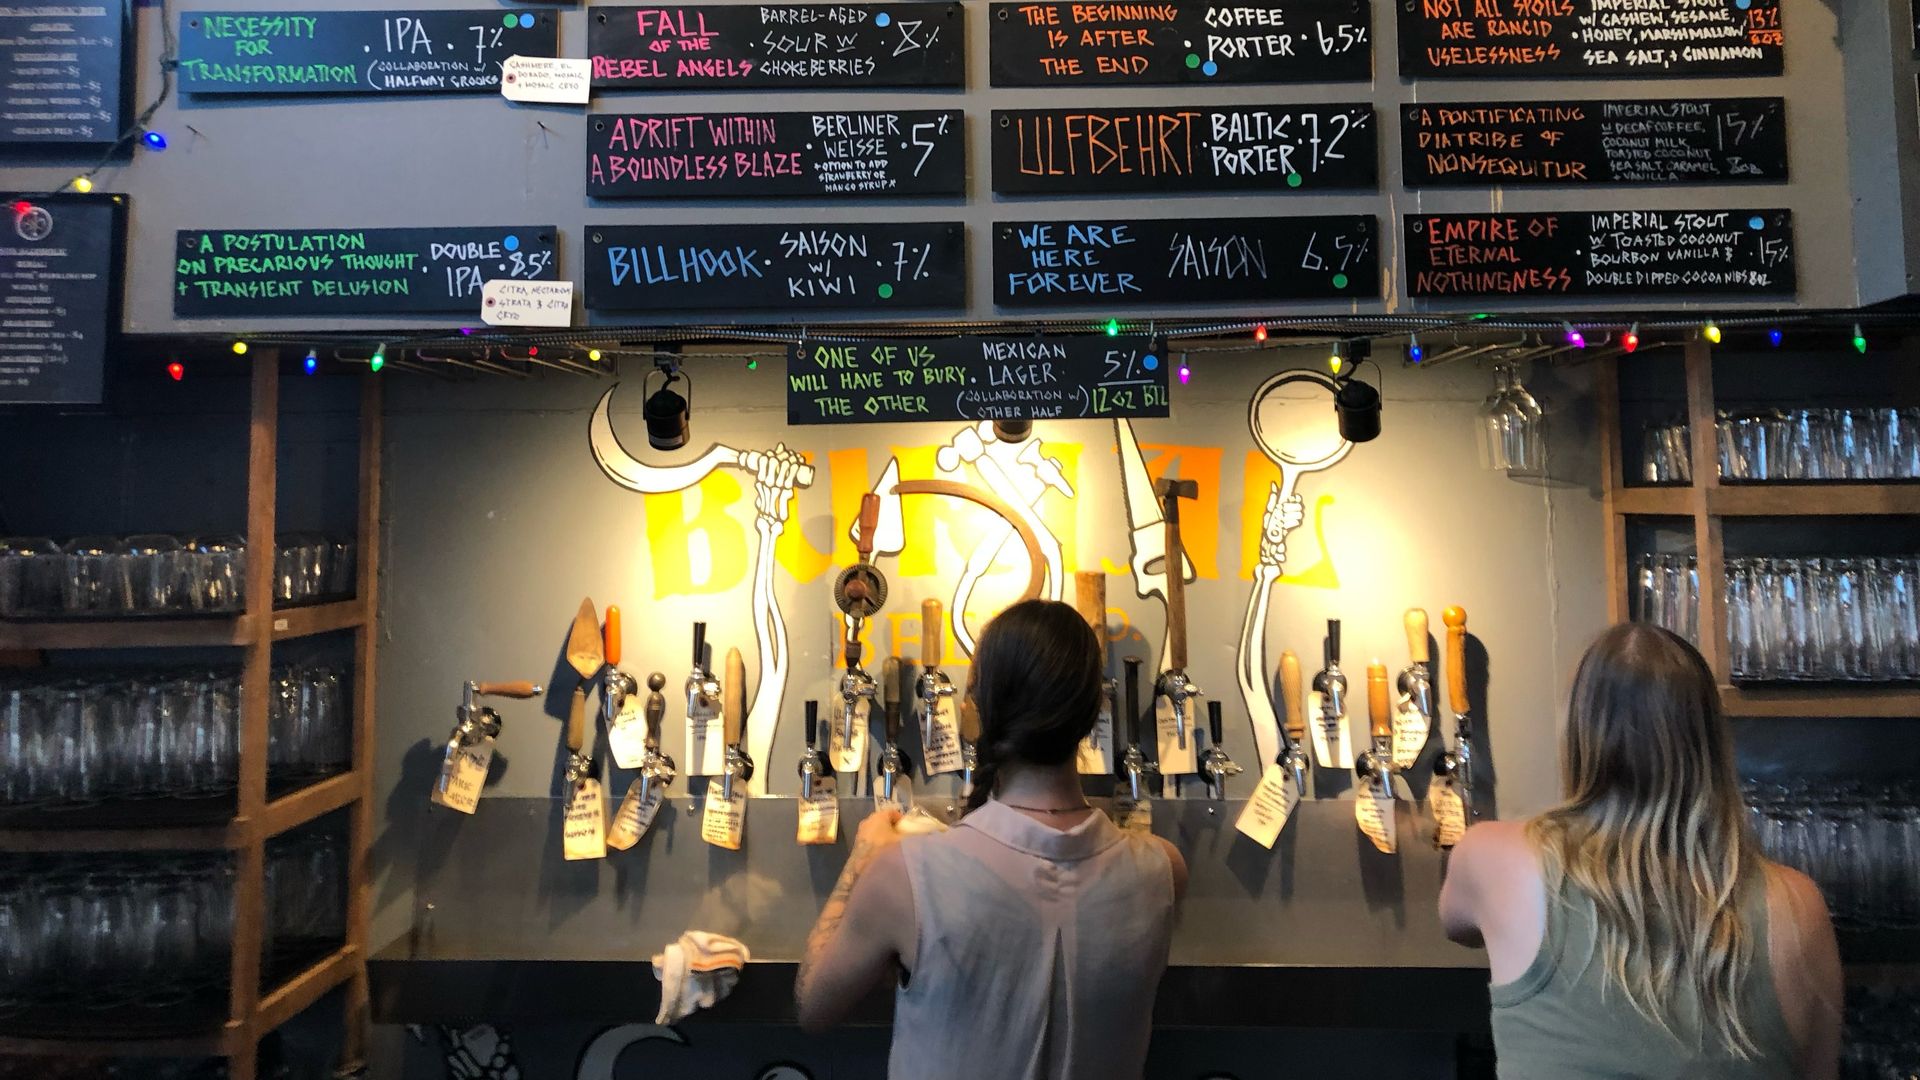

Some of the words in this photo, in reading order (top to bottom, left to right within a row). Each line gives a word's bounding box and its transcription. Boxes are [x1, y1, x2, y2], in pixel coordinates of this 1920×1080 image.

[761, 7, 867, 25] BARREL-AGED
[1018, 6, 1059, 26] THE
[1074, 6, 1178, 24] BEGINNING
[1205, 8, 1284, 27] COFFEE
[1424, 0, 1462, 18] NOT
[1475, 0, 1502, 18] ALL
[1514, 0, 1575, 17] SPOILS
[1601, 12, 1669, 27] CASHEW,
[1671, 8, 1735, 24] SESAME,
[1749, 7, 1778, 28] 13%
[204, 15, 317, 39] NECESSITY
[638, 10, 719, 37] FALL
[1442, 22, 1476, 39] ARE
[1488, 20, 1552, 37] RANCID
[384, 18, 432, 54] IPA
[469, 26, 504, 65] 7%
[648, 39, 670, 52] OF
[677, 37, 712, 51] THE
[763, 30, 828, 55] SOUR
[893, 20, 939, 57] 8%
[1049, 30, 1068, 49] IS
[1080, 30, 1155, 47] AFTER
[235, 38, 273, 56] FOR
[1207, 35, 1295, 61] PORTER
[1427, 44, 1561, 66] USELESSNESS
[1583, 50, 1618, 66] SEA
[1683, 47, 1763, 62] CINNAMON
[182, 59, 357, 86] TRANSFORMATION
[592, 56, 667, 78] REBEL
[677, 58, 753, 78] ANGELS
[760, 56, 876, 77] CHOKEBERRIES
[1041, 57, 1083, 76] THE
[1099, 56, 1149, 74] END
[384, 75, 444, 88] HALFWAY
[1421, 109, 1432, 126] A
[1439, 107, 1585, 126] PONTIFICATING
[1603, 104, 1669, 117] IMPERIAL
[1671, 103, 1711, 117] STOUT
[608, 116, 704, 152] ADRIFT
[708, 117, 777, 146] WITHIN
[812, 114, 900, 138] BERLINER
[1211, 111, 1291, 143] BALTIC
[1717, 113, 1764, 150] 15%
[824, 138, 888, 158] WEISSE
[912, 115, 950, 177] 5%
[1018, 112, 1201, 177] ULFBEHRT
[1419, 132, 1524, 148] DIATRIBE
[1540, 130, 1564, 147] OF
[591, 155, 605, 186] A
[610, 154, 729, 182] BOUNDLESS
[734, 151, 802, 178] BLAZE
[869, 159, 888, 168] ADD
[1211, 146, 1296, 177] PORTER
[1427, 153, 1587, 179] NONSEQUITUR
[1428, 217, 1519, 245] EMPIRE
[1528, 216, 1559, 237] OF
[1592, 213, 1668, 232] IMPERIAL
[1675, 213, 1729, 233] STOUT
[200, 233, 214, 253] A
[224, 232, 365, 253] POSTULATION
[779, 231, 867, 258] SAISON
[1018, 224, 1057, 247] WE
[1067, 225, 1136, 249] ARE
[1611, 232, 1675, 249] TOASTED
[1680, 232, 1744, 245] COCONUT
[430, 241, 502, 260] DOUBLE
[1032, 248, 1100, 268] HERE
[1168, 231, 1268, 279] SAISON
[1430, 246, 1521, 266] ETERNAL
[1591, 252, 1659, 268] BOURBON
[1667, 248, 1720, 260] VANILLA
[177, 259, 206, 274] ON
[215, 256, 334, 274] PRECARIOUS
[341, 254, 418, 271] THOUGHT
[892, 242, 931, 282] 7%
[200, 279, 304, 297] TRANSIENT
[313, 278, 409, 296] DELUSION
[447, 265, 484, 297] IPA
[788, 275, 855, 298] KIWI
[1009, 272, 1142, 295] FOREVER
[1417, 268, 1572, 294] NOTHINGNESS
[1586, 271, 1633, 286] DOUBLE
[1636, 271, 1680, 285] DIPPED
[814, 347, 859, 370] ONE
[871, 348, 898, 365] OF
[908, 347, 935, 366] US
[983, 342, 1067, 360] MEXICAN
[988, 362, 1056, 385] LAGER
[1104, 350, 1141, 379] 5%
[790, 373, 828, 392] WILL
[841, 370, 885, 390] HAVE
[893, 370, 914, 386] TO
[923, 366, 967, 385] BURY
[814, 397, 855, 417] THE
[864, 396, 930, 415] OTHER
[977, 406, 1022, 419] OTHER
